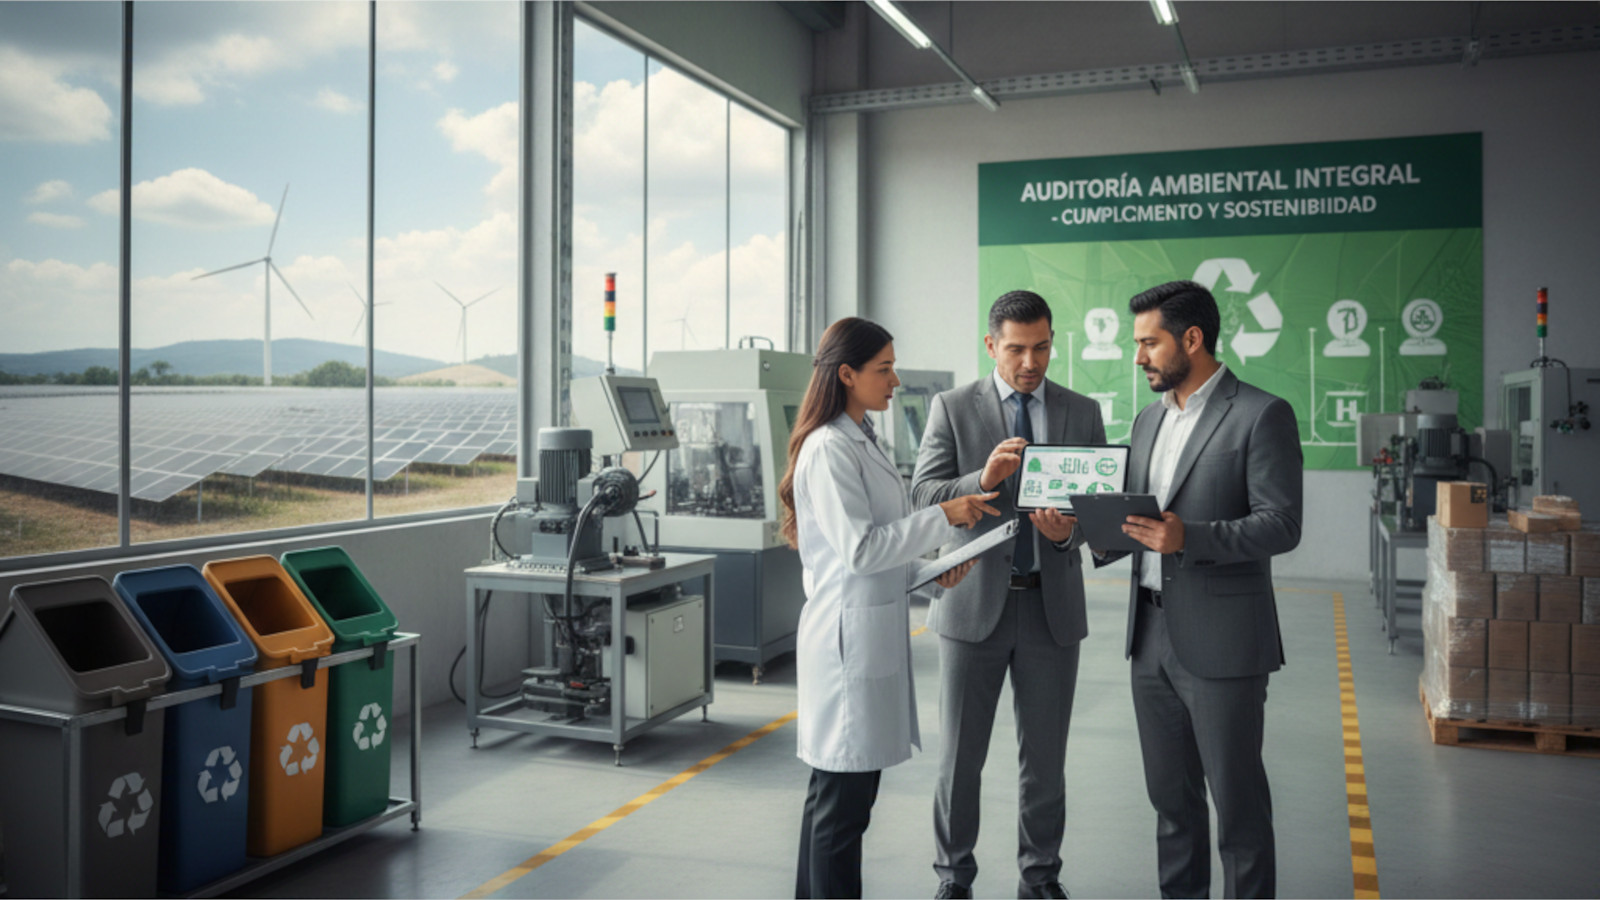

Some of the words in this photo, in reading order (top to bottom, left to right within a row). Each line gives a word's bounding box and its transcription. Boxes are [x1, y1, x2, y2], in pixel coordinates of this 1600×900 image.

[1020, 172, 1143, 203] AUDITORÍA
[1148, 170, 1288, 197] AMBIENTAL
[1295, 163, 1421, 189] INTEGRAL
[1207, 202, 1220, 219] Y
